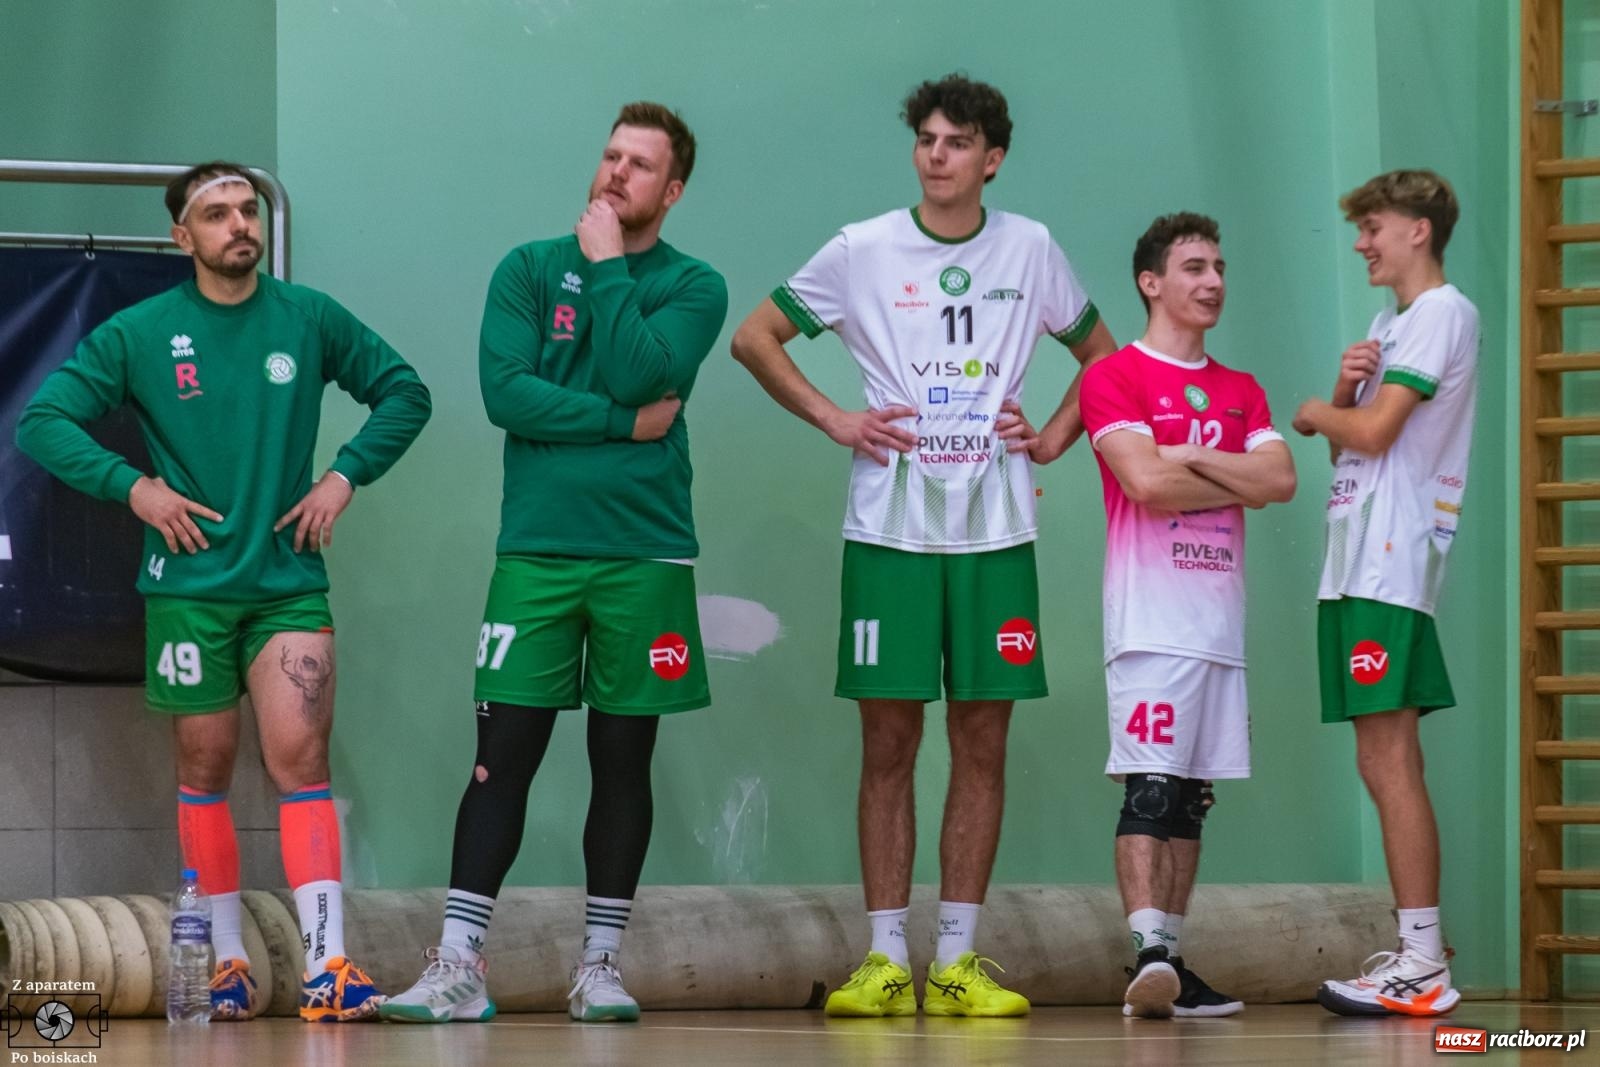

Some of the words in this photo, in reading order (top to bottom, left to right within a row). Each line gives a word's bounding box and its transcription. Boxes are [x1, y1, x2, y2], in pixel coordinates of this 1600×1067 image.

[553, 304, 576, 332] R
[940, 305, 973, 345] 11
[175, 362, 199, 389] R
[157, 642, 202, 686] 49
[475, 622, 517, 670] 87
[853, 619, 880, 666] 11
[1125, 701, 1174, 745] 42
